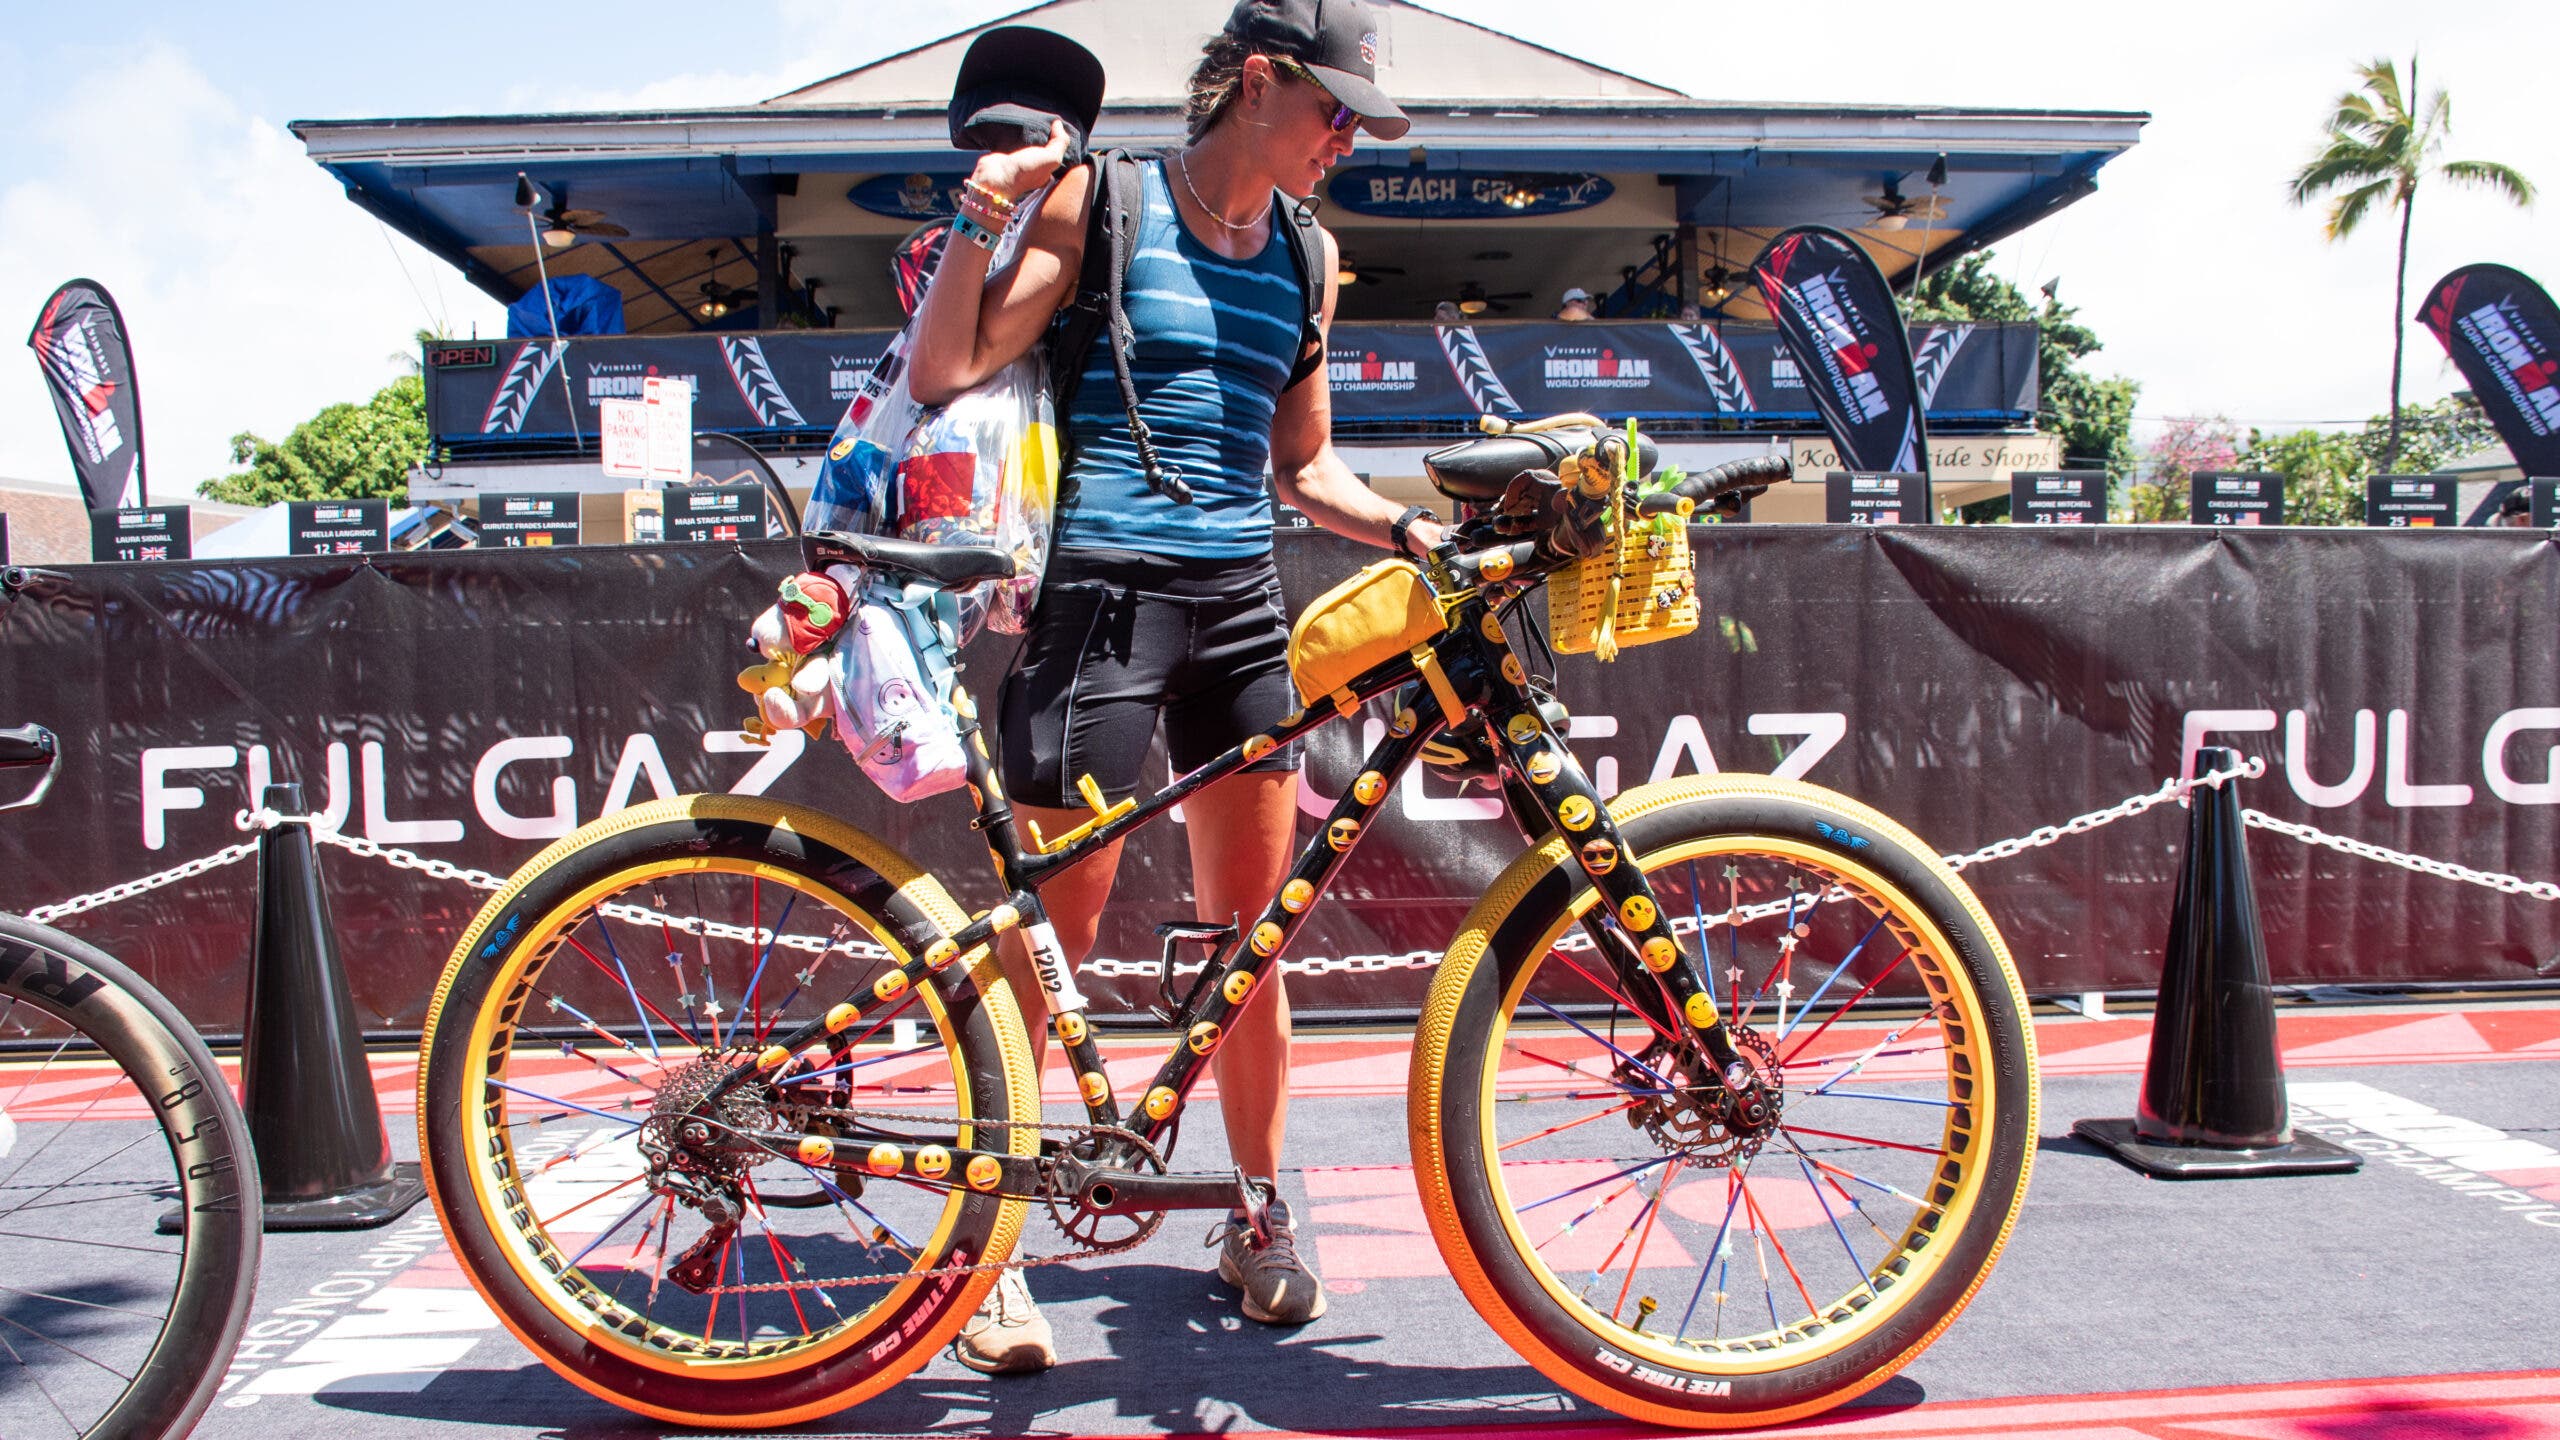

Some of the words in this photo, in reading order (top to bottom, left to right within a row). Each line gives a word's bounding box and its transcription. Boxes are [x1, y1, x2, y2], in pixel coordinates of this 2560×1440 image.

[1369, 176, 1457, 203] BEACH
[1837, 284, 1869, 337] VINFAST
[1326, 350, 1361, 358] INFAST
[1800, 273, 1889, 421] IRONMAN
[427, 347, 490, 366] OPEN
[1545, 349, 1650, 378] IRONMAN
[602, 364, 642, 372] VINFAST
[1327, 352, 1416, 381] ONMAN
[2469, 303, 2560, 431] IRONMAN
[1546, 379, 1579, 388] WORLD
[1581, 379, 1650, 388] CHAMPIONSHIP
[1811, 330, 1864, 425] CHAMPIONSHIP
[2457, 316, 2491, 356] WORLD
[2484, 351, 2548, 436] CHAMPIONSHIP
[1343, 382, 1416, 391] CHAMPIONSHIP
[607, 424, 648, 440] PARKING
[1981, 446, 2049, 471] Shops
[696, 515, 756, 524] STAGE-NIELSEN
[1291, 517, 1308, 528] 19
[1851, 512, 1867, 524] 22
[2035, 513, 2052, 524] 23
[2214, 513, 2230, 524] 24
[2389, 516, 2406, 526] 25
[335, 529, 377, 537] LANGRIDGE
[504, 536, 521, 547] 14
[689, 531, 706, 541] 15
[119, 549, 135, 560] 11
[314, 544, 330, 554] 12
[141, 730, 805, 850] FULGAZ
[1033, 945, 1062, 995] 1202
[902, 1288, 945, 1338] TIRE
[868, 1330, 902, 1362] CO.
[1595, 1346, 1633, 1374] CO.
[1631, 1365, 1686, 1391] TIRE
[1686, 1379, 1731, 1397] VEE
